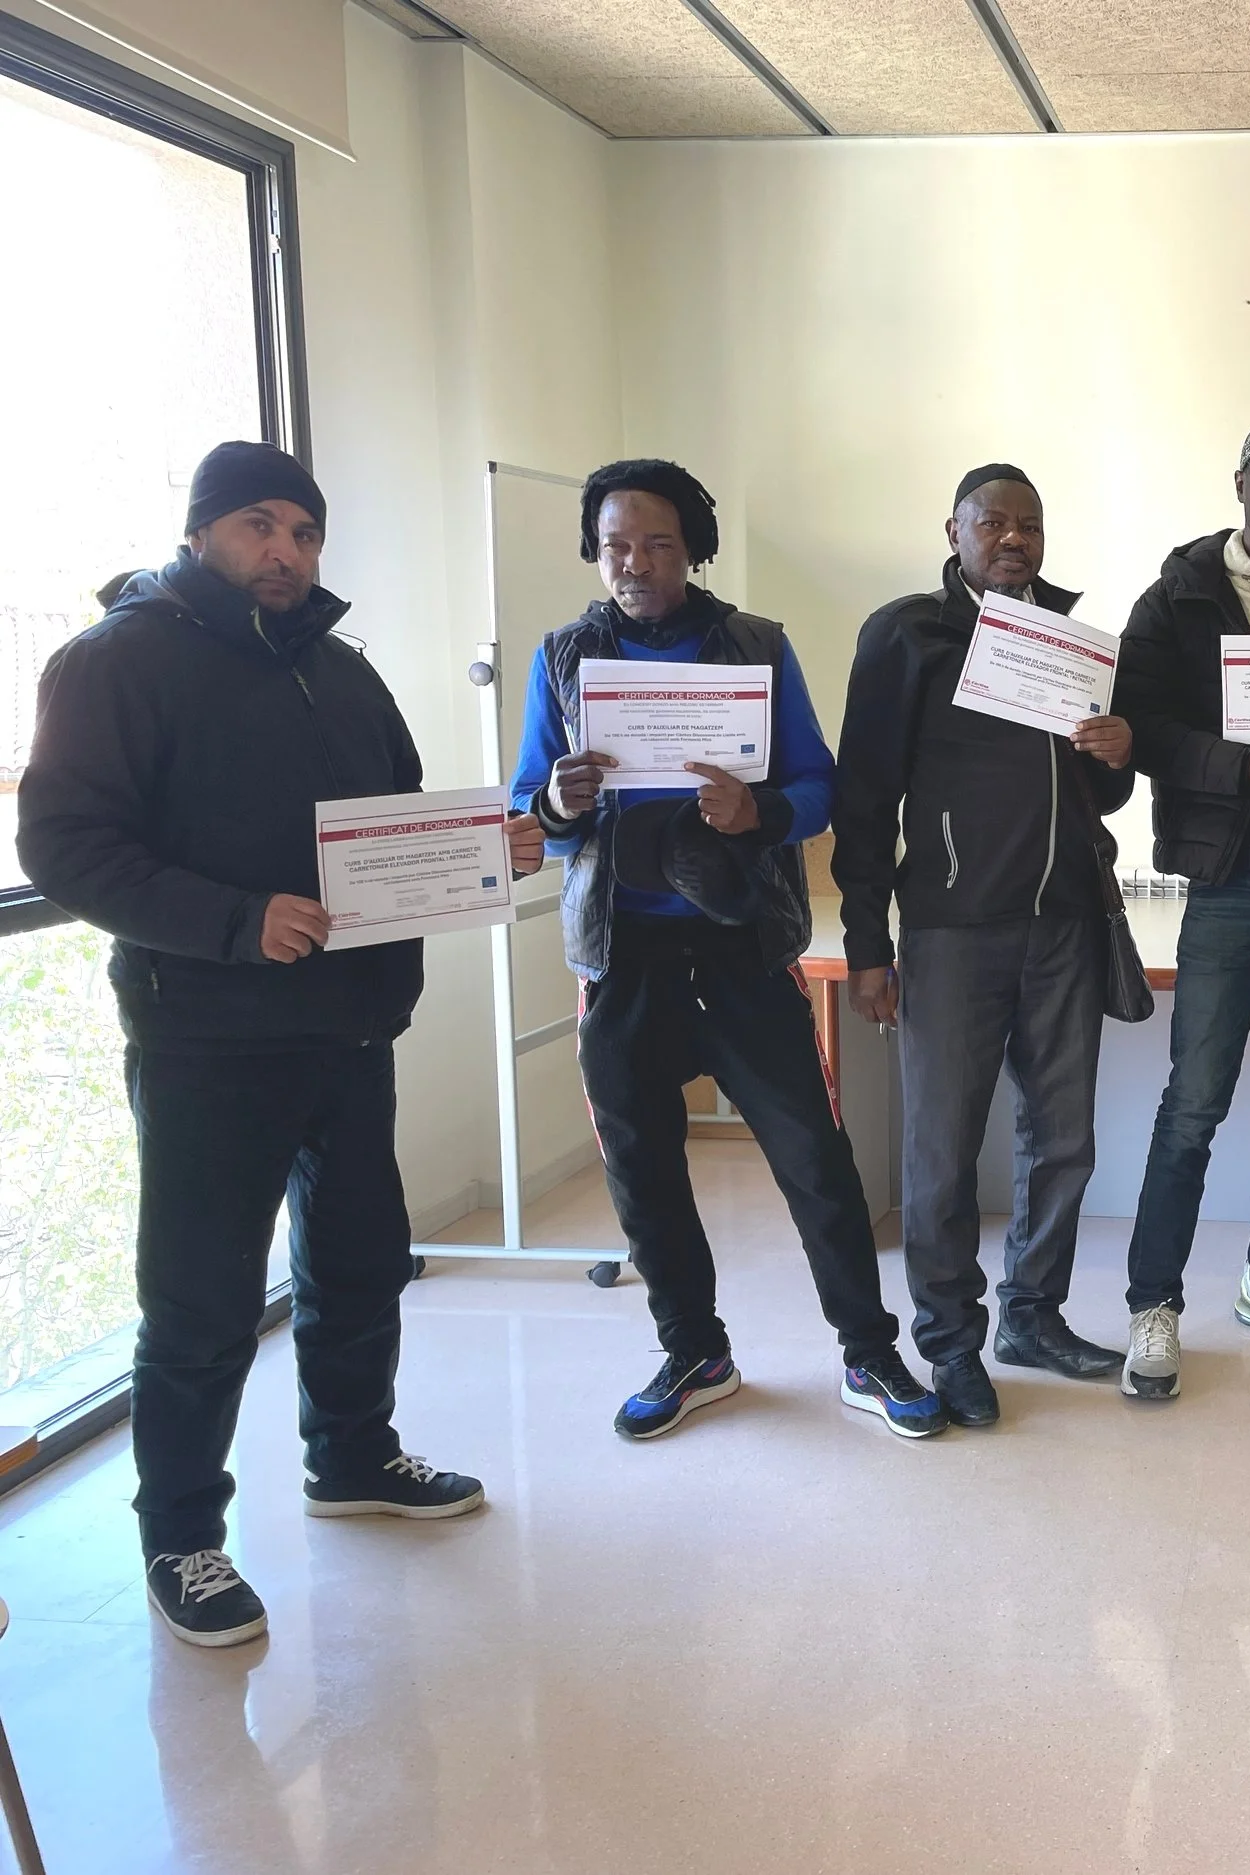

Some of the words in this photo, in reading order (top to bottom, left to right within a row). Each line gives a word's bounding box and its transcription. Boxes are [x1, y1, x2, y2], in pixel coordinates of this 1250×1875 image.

[1008, 625, 1048, 642] CERTIFICAT
[1060, 642, 1095, 658] FORMACIÓ
[618, 692, 670, 700] CERTIFICAT
[671, 692, 684, 700] DE
[687, 690, 735, 700] FORMACIÓ
[356, 824, 408, 838] CERTIFICAT
[410, 824, 424, 832] DE
[425, 818, 473, 831] FORMACIÓ
